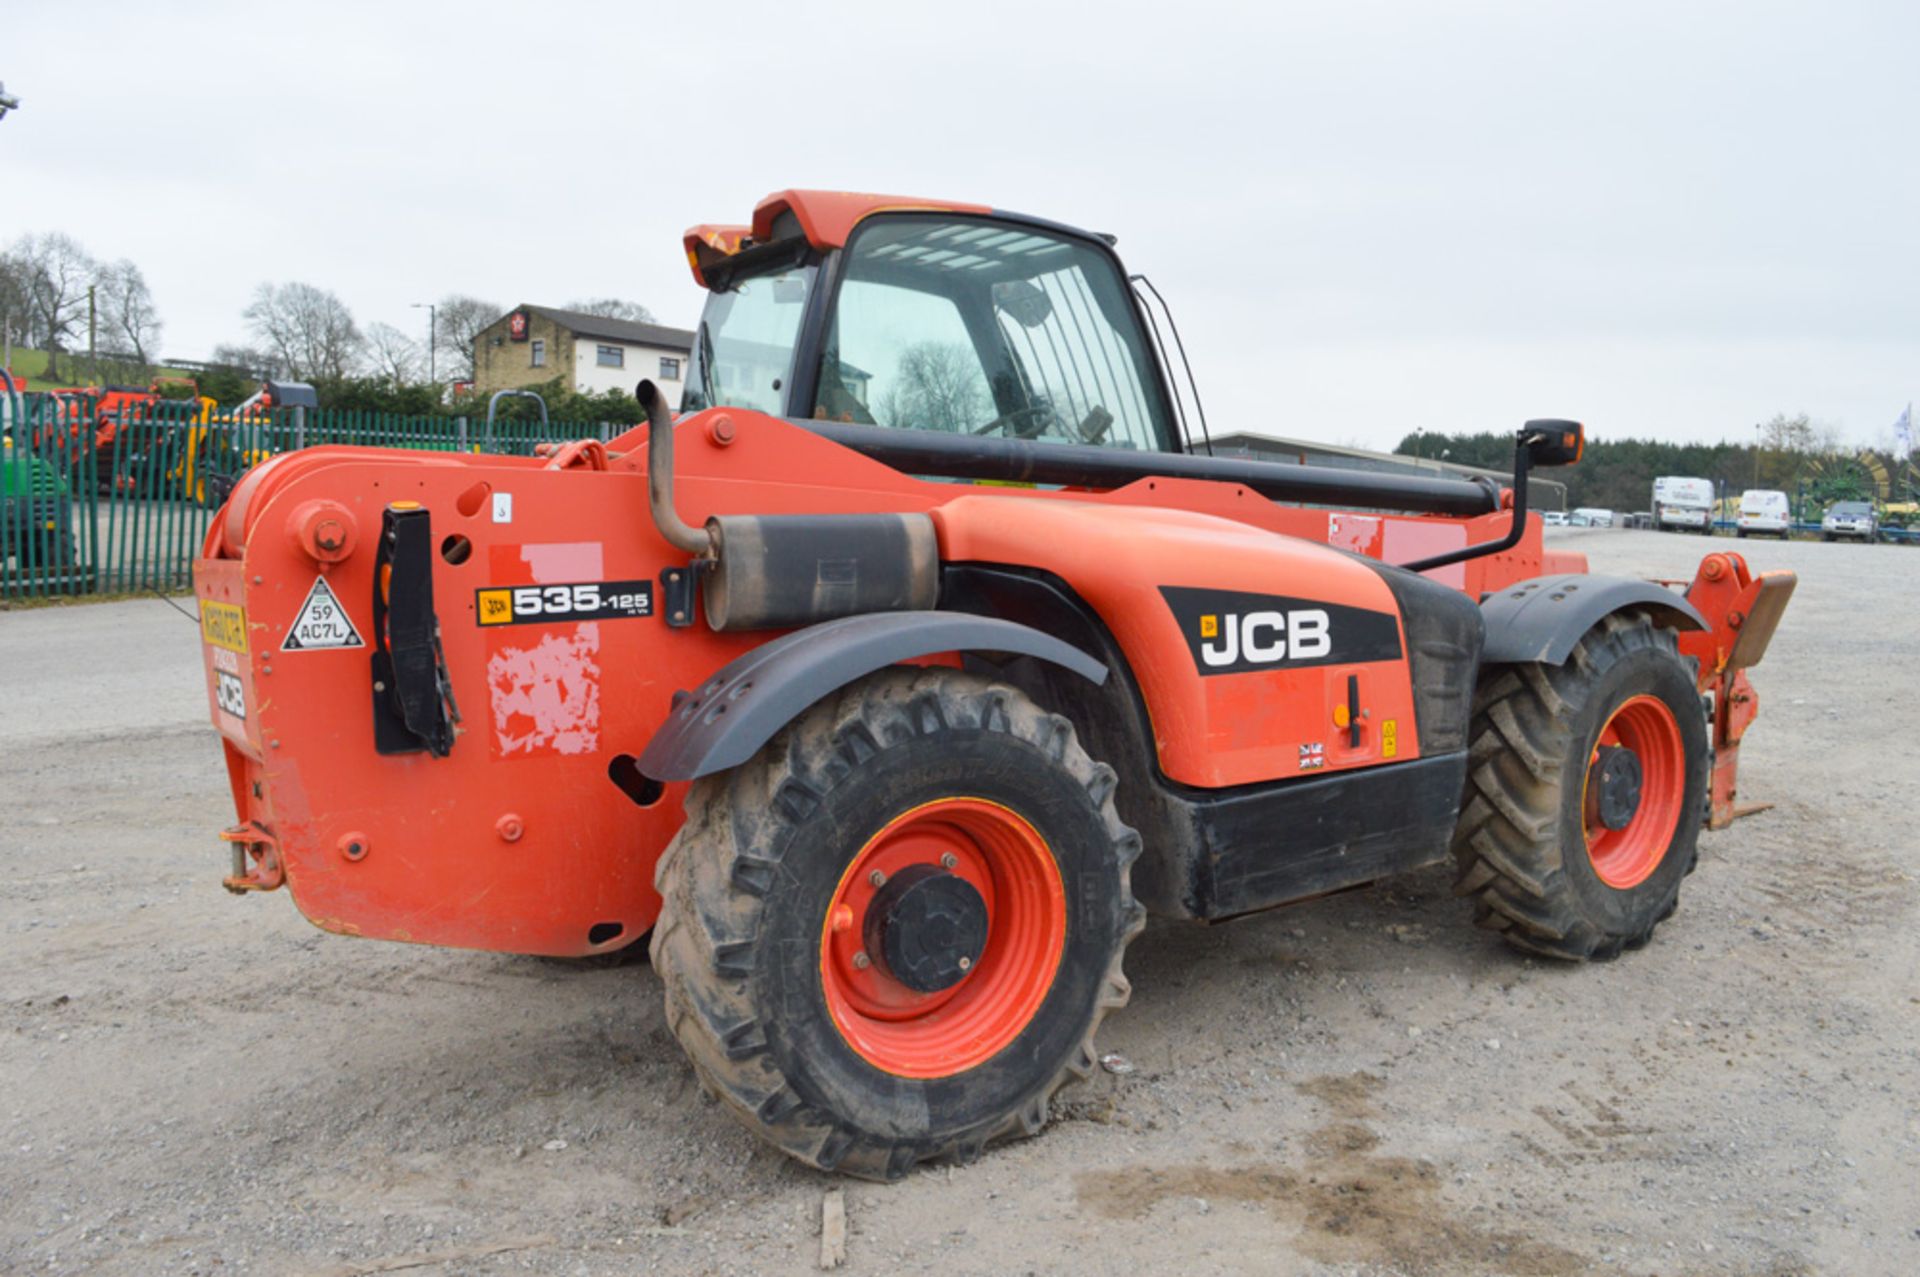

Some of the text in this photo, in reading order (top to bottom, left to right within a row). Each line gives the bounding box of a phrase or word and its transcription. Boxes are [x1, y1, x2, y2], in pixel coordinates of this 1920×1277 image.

[312, 605, 333, 621] 59
[513, 584, 648, 615] 535-125
[301, 623, 344, 640] AC7L
[1202, 609, 1331, 666] JCB
[215, 671, 246, 719] JCB
